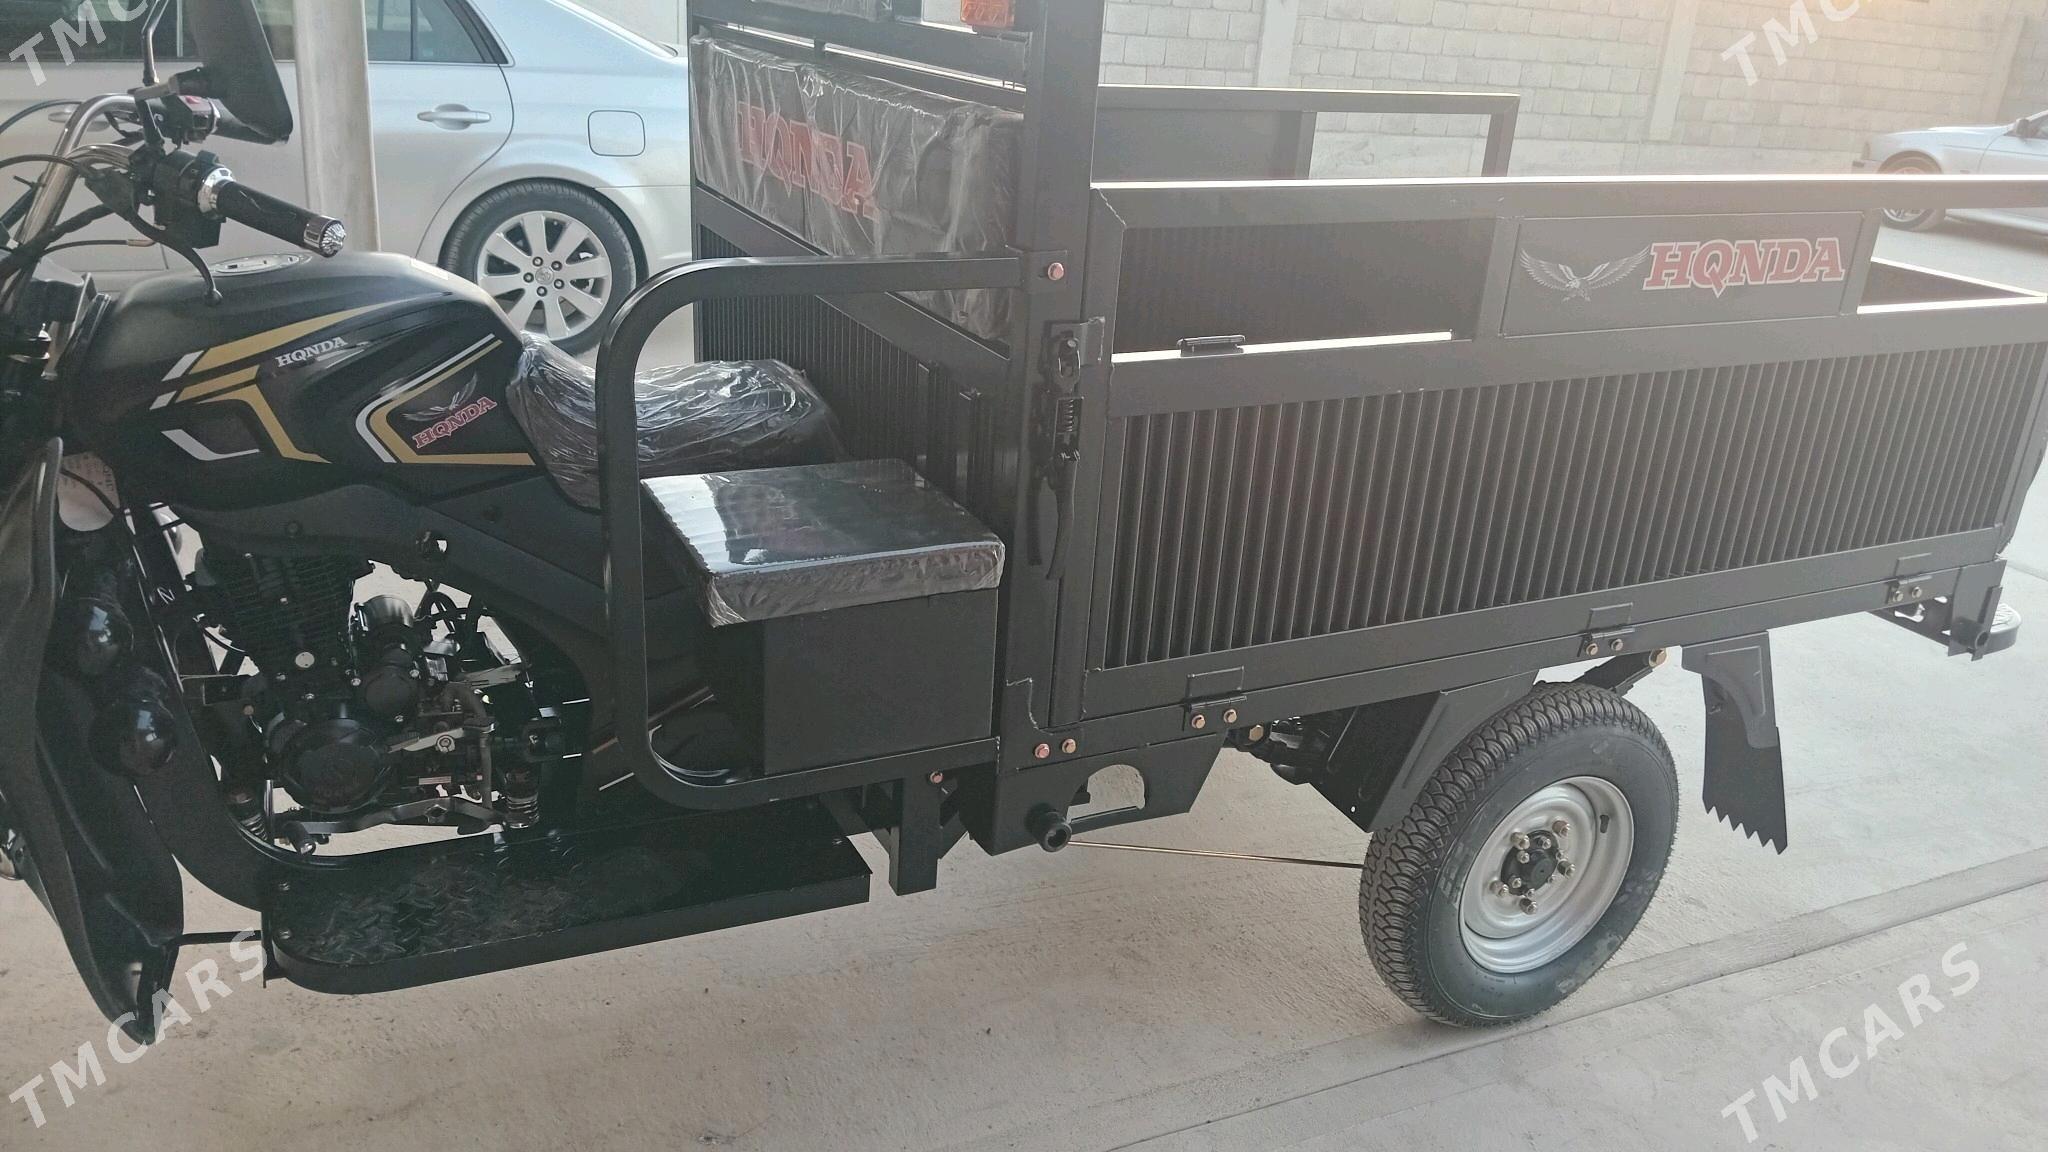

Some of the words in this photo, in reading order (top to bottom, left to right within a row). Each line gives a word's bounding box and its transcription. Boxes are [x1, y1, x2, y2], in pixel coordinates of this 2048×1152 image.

[1642, 237, 1845, 298] HQNDA
[275, 336, 349, 368] HQNDA
[412, 396, 498, 449] HQNDA
